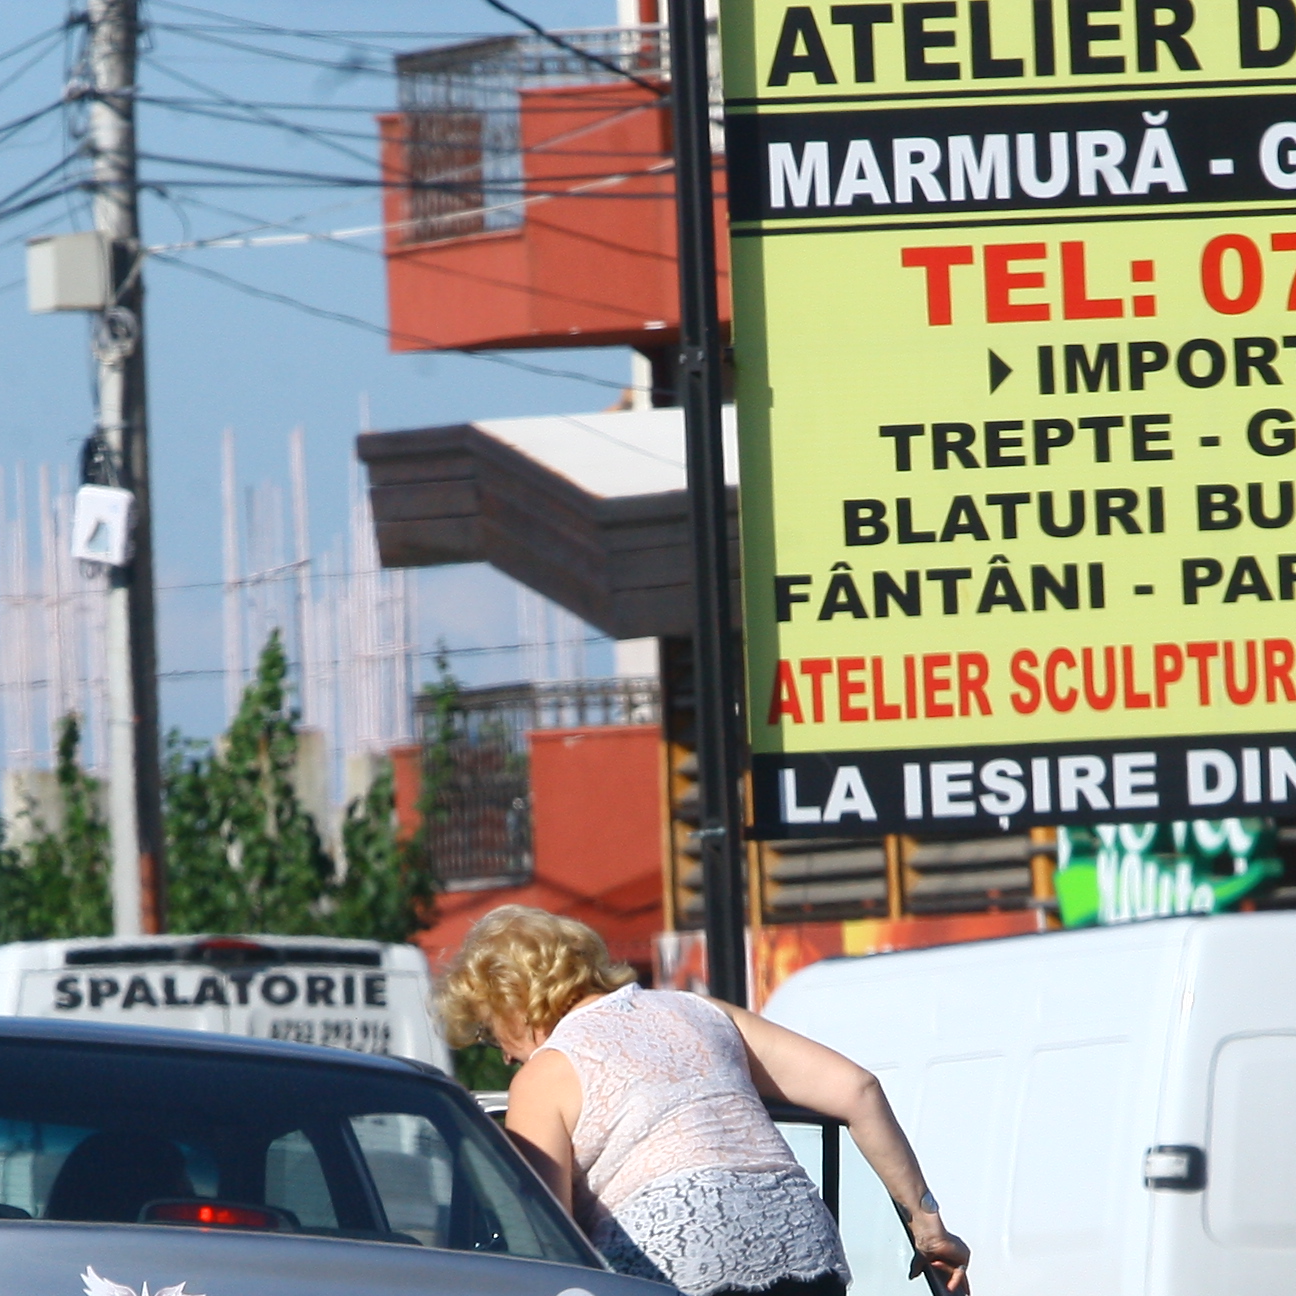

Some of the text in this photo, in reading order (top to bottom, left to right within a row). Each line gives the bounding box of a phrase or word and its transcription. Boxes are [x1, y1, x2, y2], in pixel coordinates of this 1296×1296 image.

[767, 0, 1201, 87] ATELIER
[769, 111, 1187, 208] MARMURĂ
[1210, 159, 1233, 174] -
[902, 241, 1156, 325] TEL:
[880, 414, 1173, 471] TREPTE
[1201, 437, 1219, 446] -
[844, 487, 1164, 546] BLATURI
[775, 555, 1104, 622] FÂNTÂNI
[1135, 586, 1153, 594] -
[768, 653, 992, 725] ATELIER
[781, 766, 877, 824] LA
[904, 753, 1158, 829] IEȘIRE
[56, 975, 387, 1009] SPALATORIE
